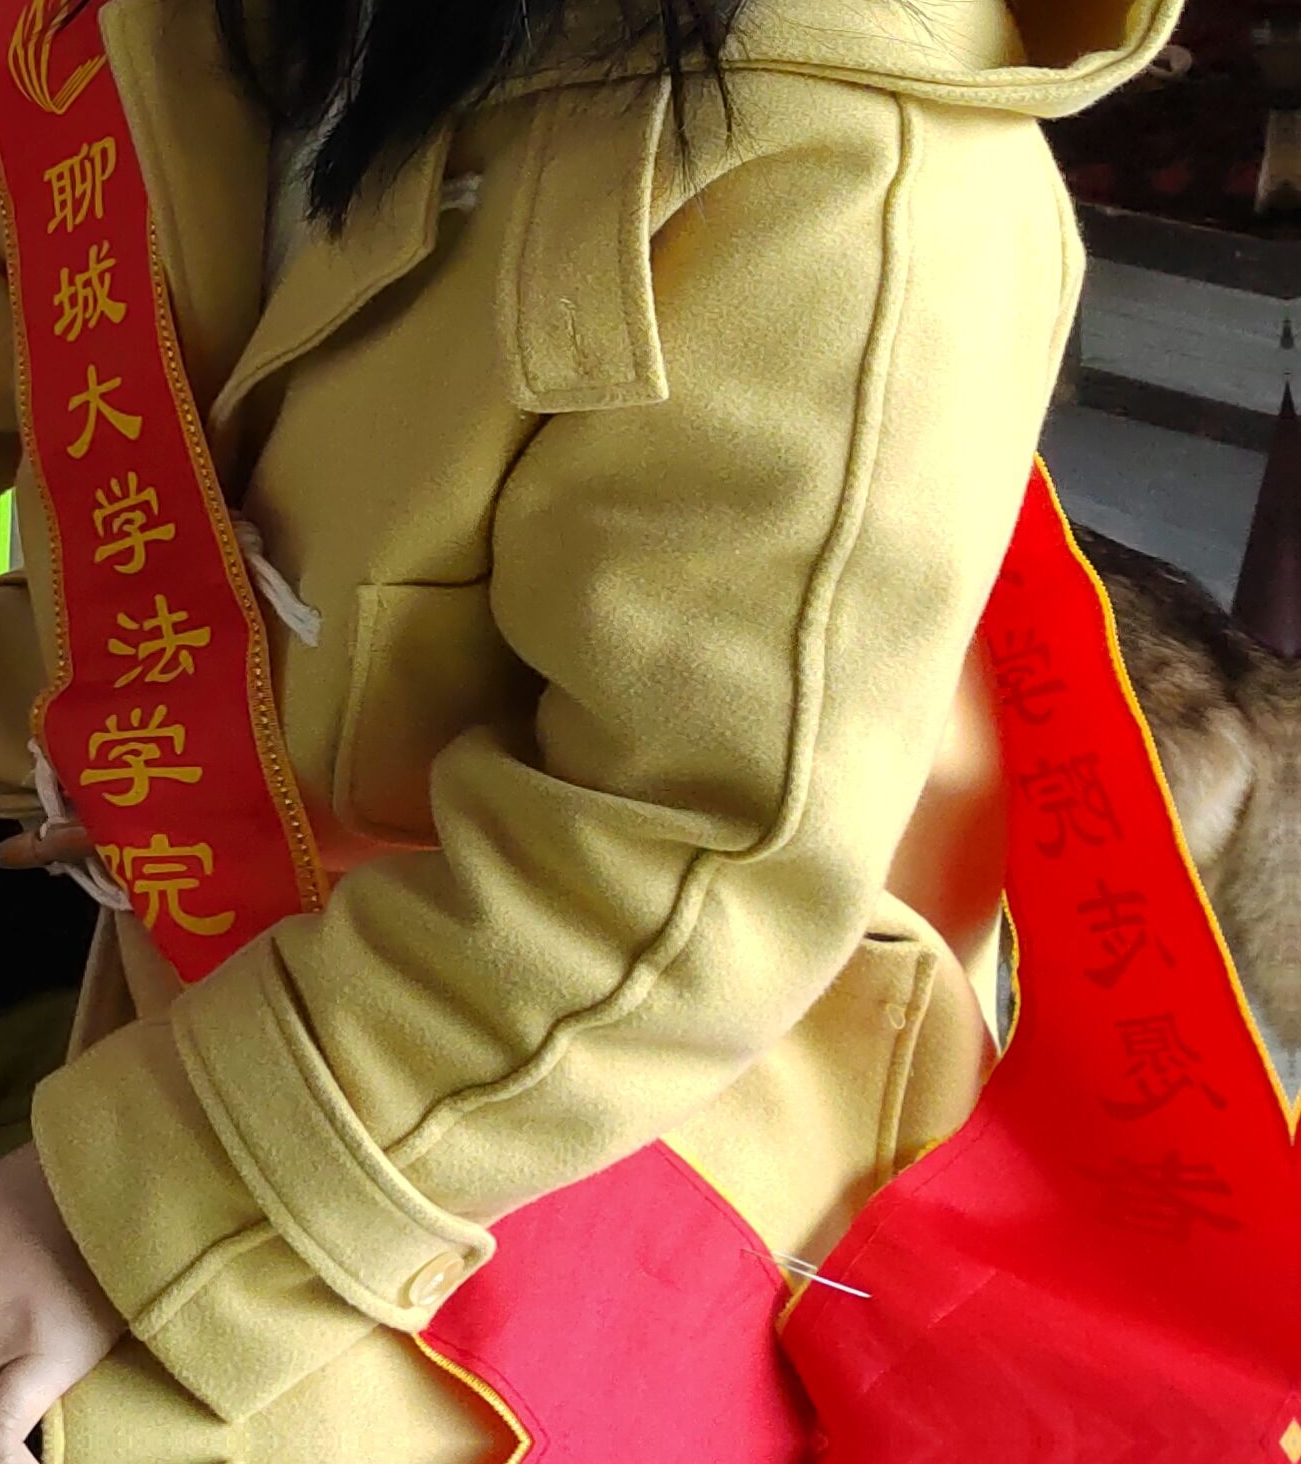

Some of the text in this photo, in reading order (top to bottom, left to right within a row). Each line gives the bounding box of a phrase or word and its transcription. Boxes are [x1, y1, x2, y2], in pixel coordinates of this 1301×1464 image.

[43, 136, 237, 936] 聊城大学法学院
